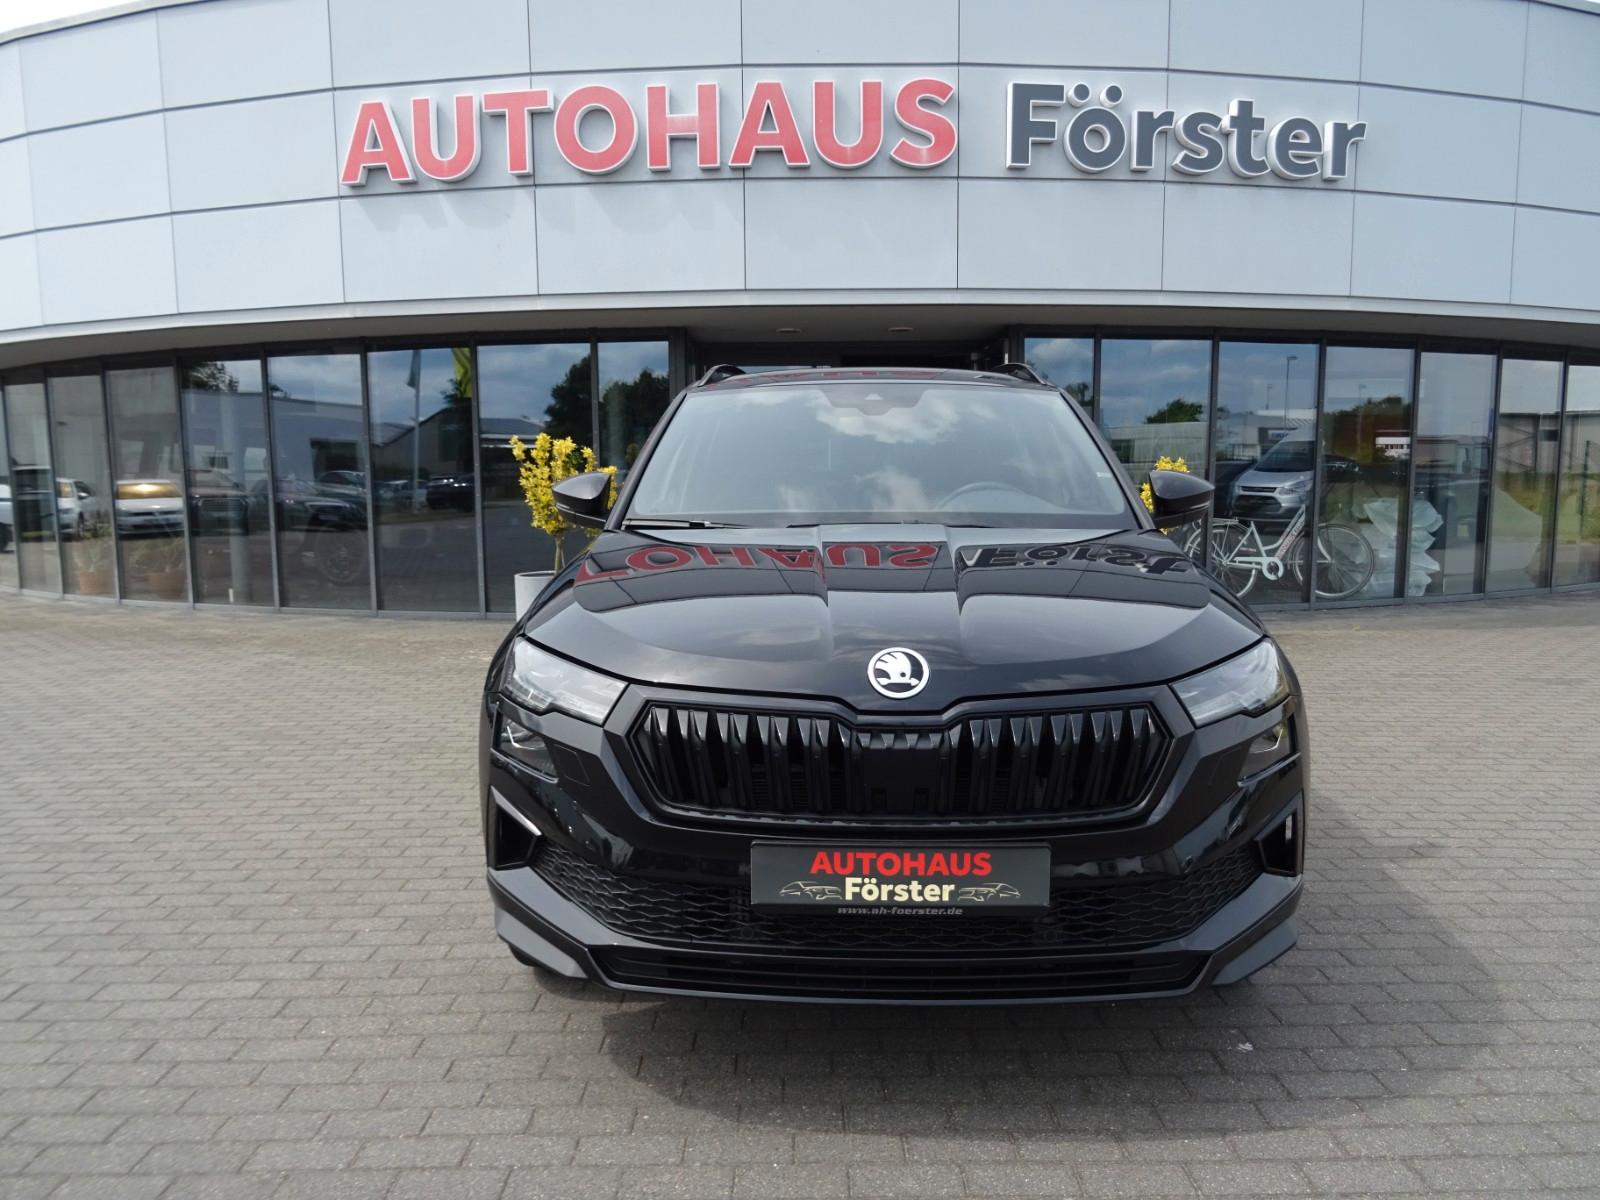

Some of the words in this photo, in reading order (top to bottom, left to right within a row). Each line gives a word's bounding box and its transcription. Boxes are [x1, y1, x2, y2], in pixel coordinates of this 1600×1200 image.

[339, 78, 958, 186] AUTOHAUS
[1006, 81, 1367, 182] Förster
[809, 851, 993, 877] AUTOHAUS
[844, 876, 956, 902] Förster
[836, 905, 964, 916] www.ah-foerster.de
